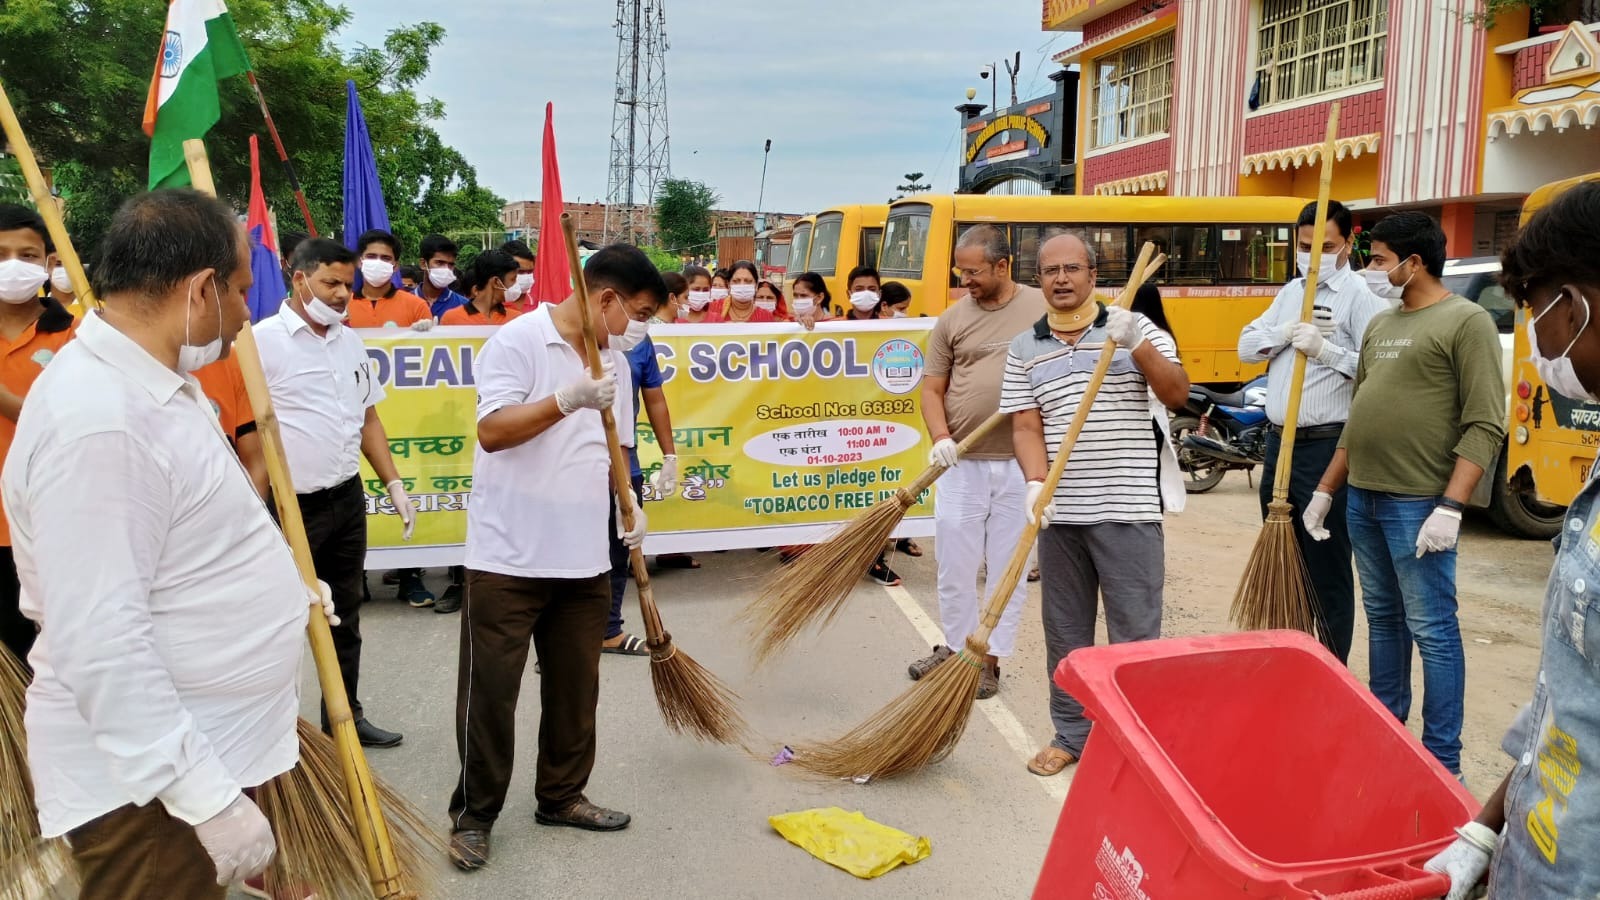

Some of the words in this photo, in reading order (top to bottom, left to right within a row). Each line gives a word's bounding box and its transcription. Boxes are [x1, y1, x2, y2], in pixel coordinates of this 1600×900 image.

[1226, 286, 1249, 297] CBSE
[365, 346, 476, 387] DEAL
[689, 340, 868, 382] SCHOOL
[757, 403, 820, 419] School
[825, 402, 856, 417] No:
[861, 399, 914, 416] 66892
[772, 431, 791, 442] एक
[794, 428, 828, 440] तारीख
[838, 427, 864, 437] 10:00
[866, 426, 881, 436] AM
[886, 426, 896, 434] to
[387, 435, 466, 458] वच्छ
[846, 439, 871, 449] 11:00
[872, 438, 888, 447] AM
[779, 448, 798, 457] एक
[801, 445, 822, 455] घंटा
[807, 452, 863, 465] 01-10-2023
[773, 472, 798, 488] Let
[804, 474, 821, 487] us
[826, 468, 876, 490] pledge
[880, 466, 901, 481] for
[744, 496, 830, 514] “TOBACCO
[834, 491, 874, 509] FREE
